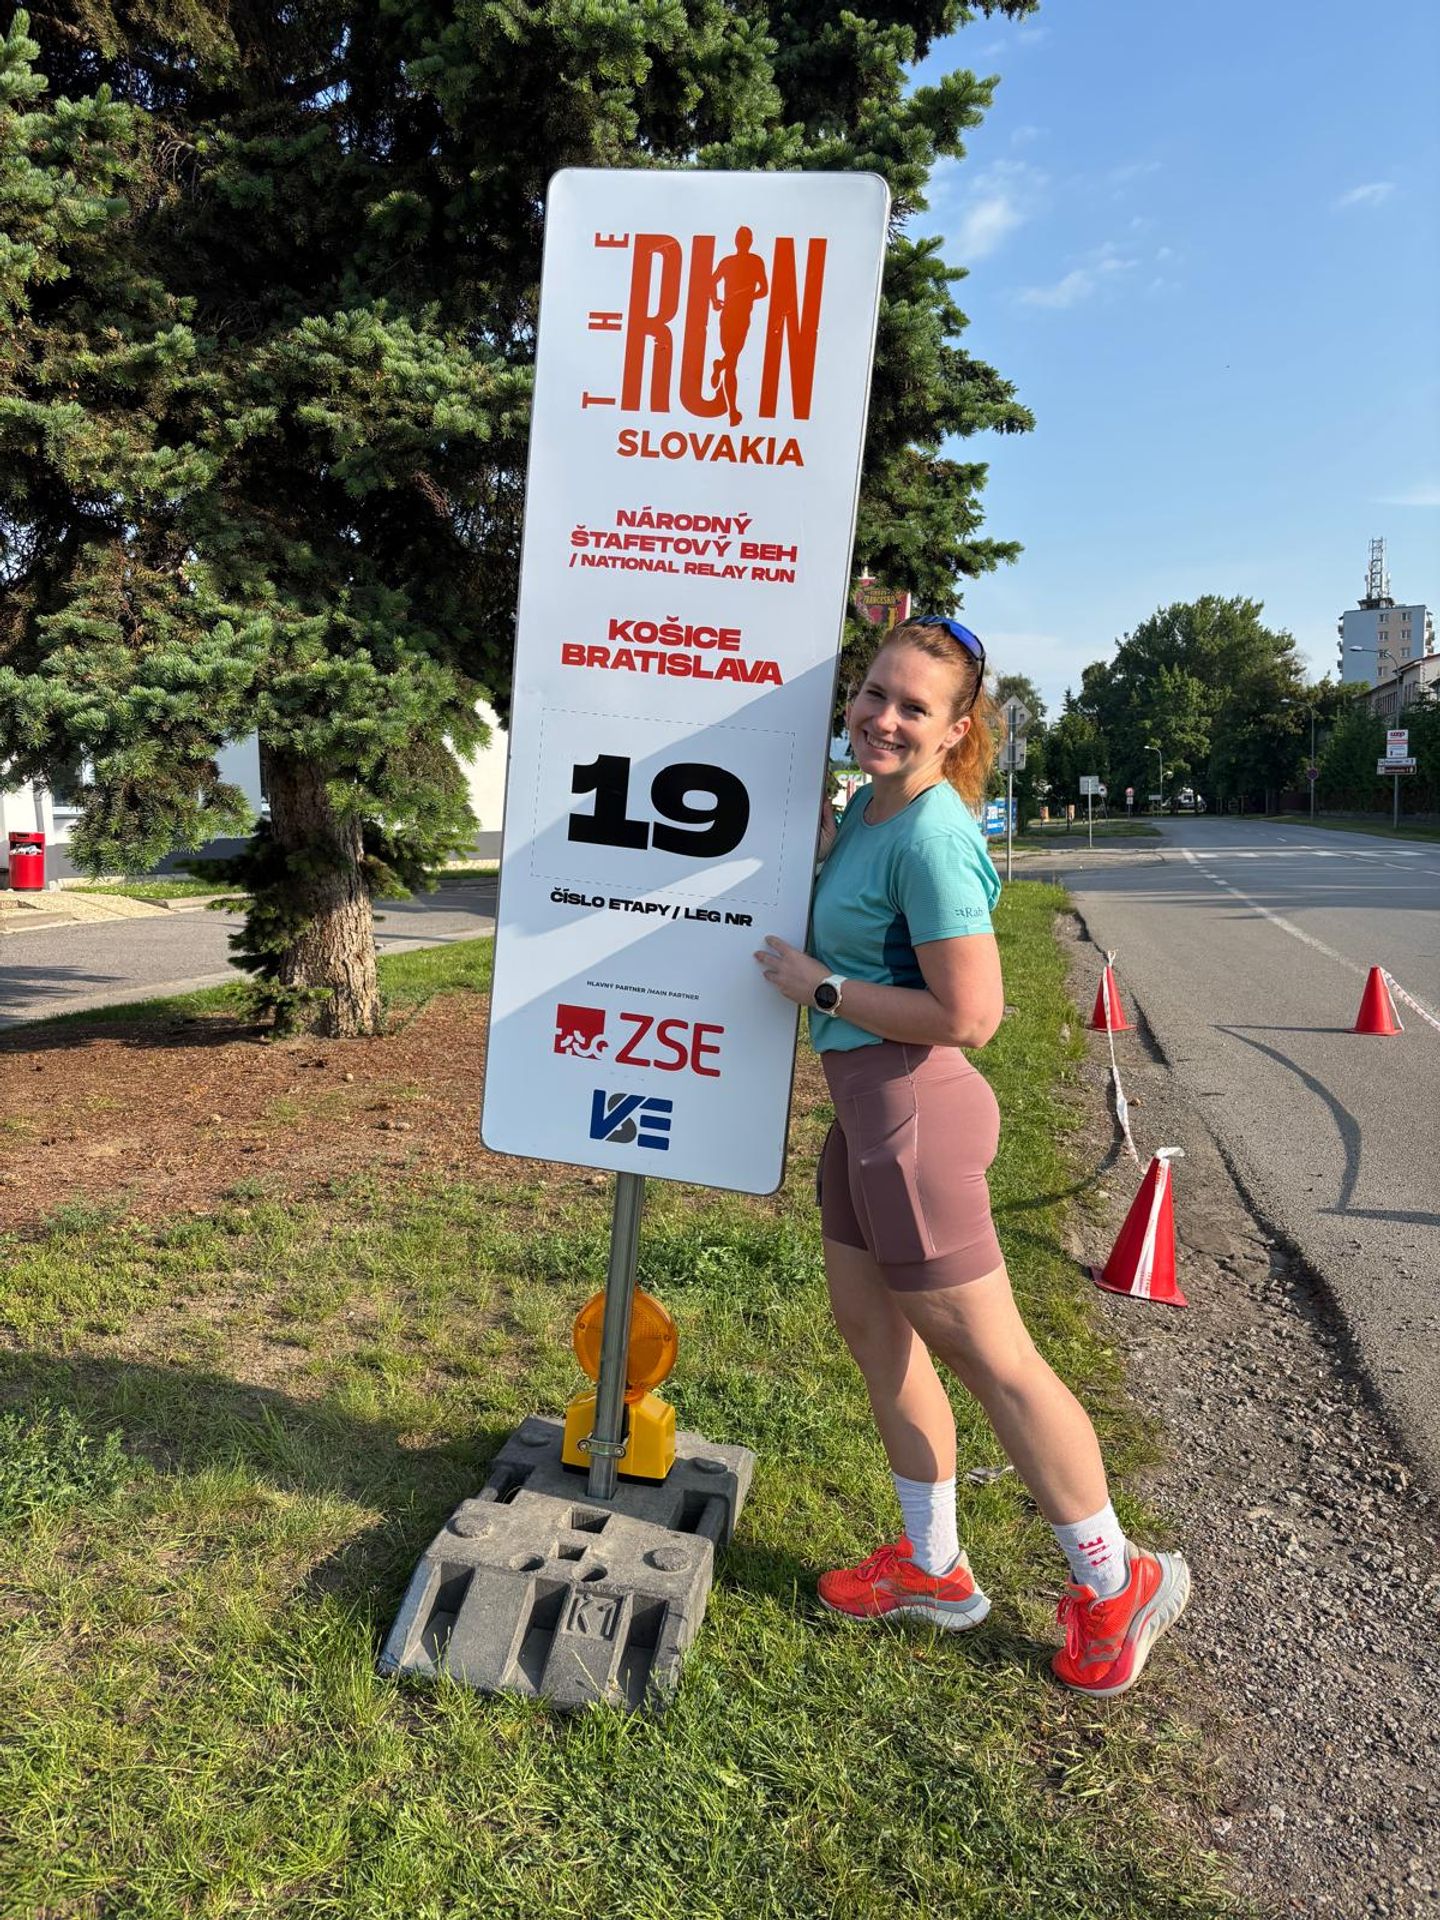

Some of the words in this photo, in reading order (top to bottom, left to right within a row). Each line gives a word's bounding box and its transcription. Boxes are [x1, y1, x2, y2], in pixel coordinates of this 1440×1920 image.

[621, 226, 827, 427] RUN
[616, 428, 805, 467] SLOVAKIA
[616, 506, 753, 535] NÁRODNÝ
[570, 524, 732, 557] ŠTAFETOVÝ
[740, 542, 798, 562] BEH
[581, 554, 680, 574] NATIONAL
[684, 561, 749, 579] RELAY
[751, 566, 796, 583] RUN
[608, 615, 742, 652] KOŠICE
[561, 643, 783, 686] BRATISLAVA
[568, 754, 750, 858] 19
[550, 887, 605, 909] ČÍSLO
[608, 898, 671, 917] ETAPY
[684, 906, 721, 923] LEG
[725, 912, 753, 927] NR
[615, 984, 646, 994] PARTNER
[669, 991, 700, 1001] PARTNER
[615, 1012, 725, 1077] ZSE
[589, 1089, 673, 1151] VSE
